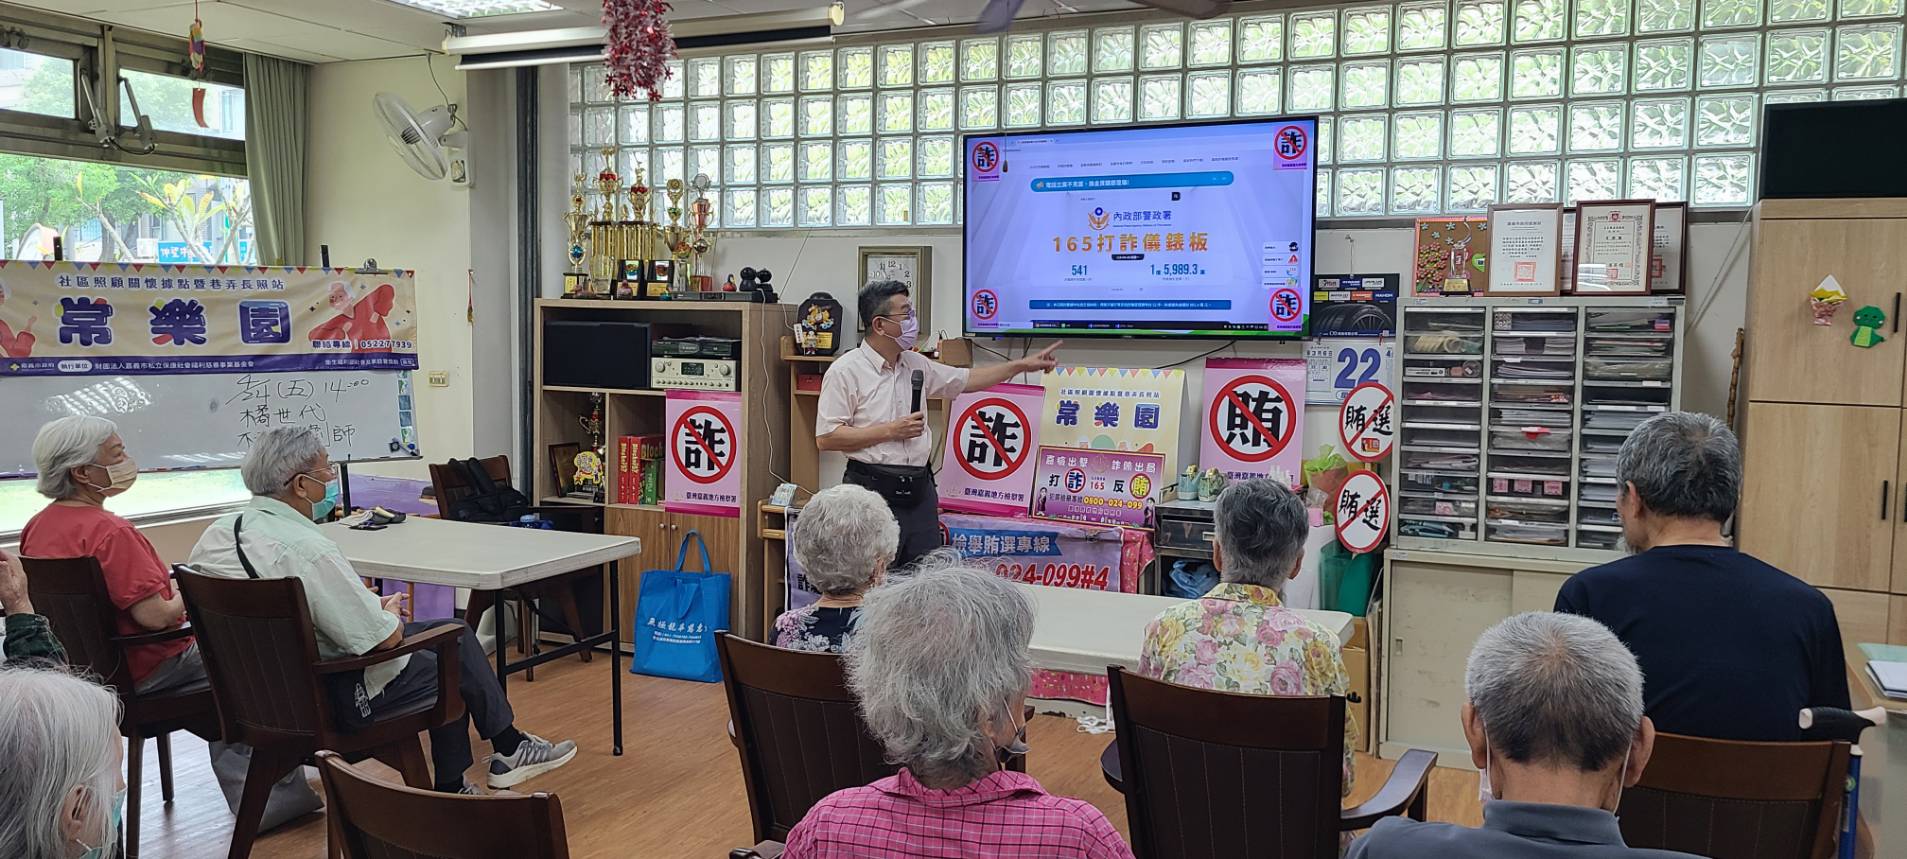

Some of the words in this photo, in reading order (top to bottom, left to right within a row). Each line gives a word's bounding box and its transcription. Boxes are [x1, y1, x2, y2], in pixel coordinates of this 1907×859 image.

[1281, 130, 1304, 154] 詐
[975, 146, 996, 168] 詐
[1113, 210, 1172, 221] 內政部警政署
[1053, 231, 1208, 253] 165打詐儀錶板
[887, 260, 897, 268] 12
[904, 270, 911, 278] 2
[1071, 264, 1088, 276] 541
[58, 274, 285, 291] 社區照顧關懷據點暨巷弄長照站
[906, 280, 912, 289] 3
[975, 292, 996, 314] 詐
[1275, 292, 1299, 316] 詐
[58, 296, 292, 346] 常樂園
[1334, 347, 1381, 388] 22
[1056, 400, 1160, 430] 常樂園
[1226, 390, 1284, 448] 賄
[1344, 404, 1393, 436] 賄選
[684, 418, 726, 471] 詐
[966, 411, 1021, 467] 詐
[1090, 481, 1105, 490] 165
[1338, 488, 1381, 532] 賄選
[952, 532, 1051, 554] 檢舉賄選專線
